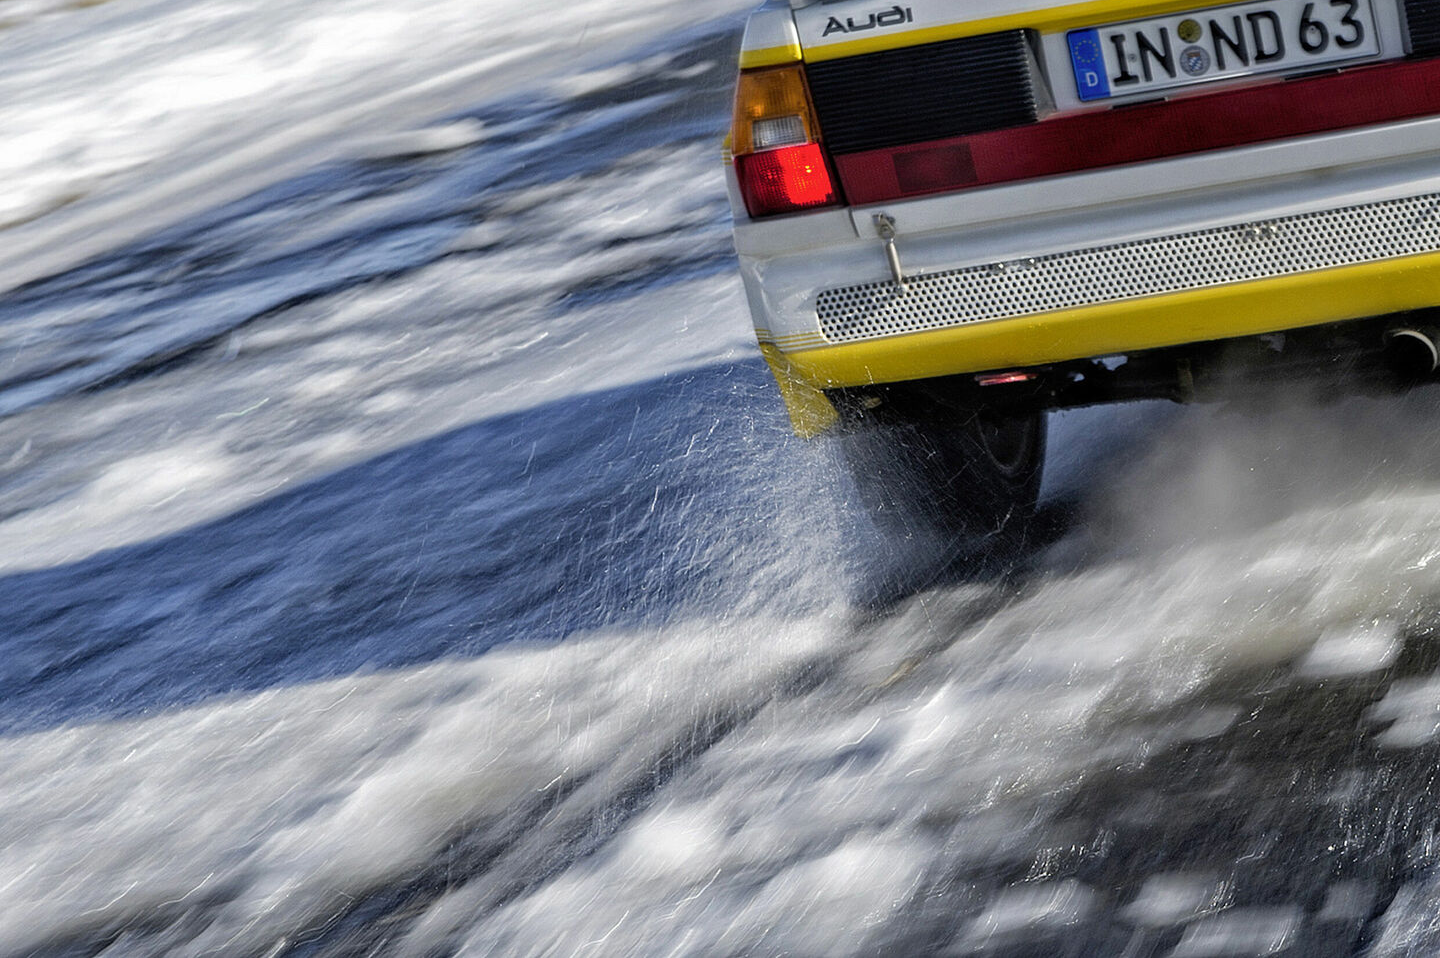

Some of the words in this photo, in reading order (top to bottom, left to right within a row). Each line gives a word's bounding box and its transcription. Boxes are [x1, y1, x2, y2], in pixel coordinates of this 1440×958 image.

[822, 5, 913, 38] Audi
[1110, 27, 1177, 87] IN
[1209, 10, 1286, 71] ND
[1085, 71, 1099, 88] D
